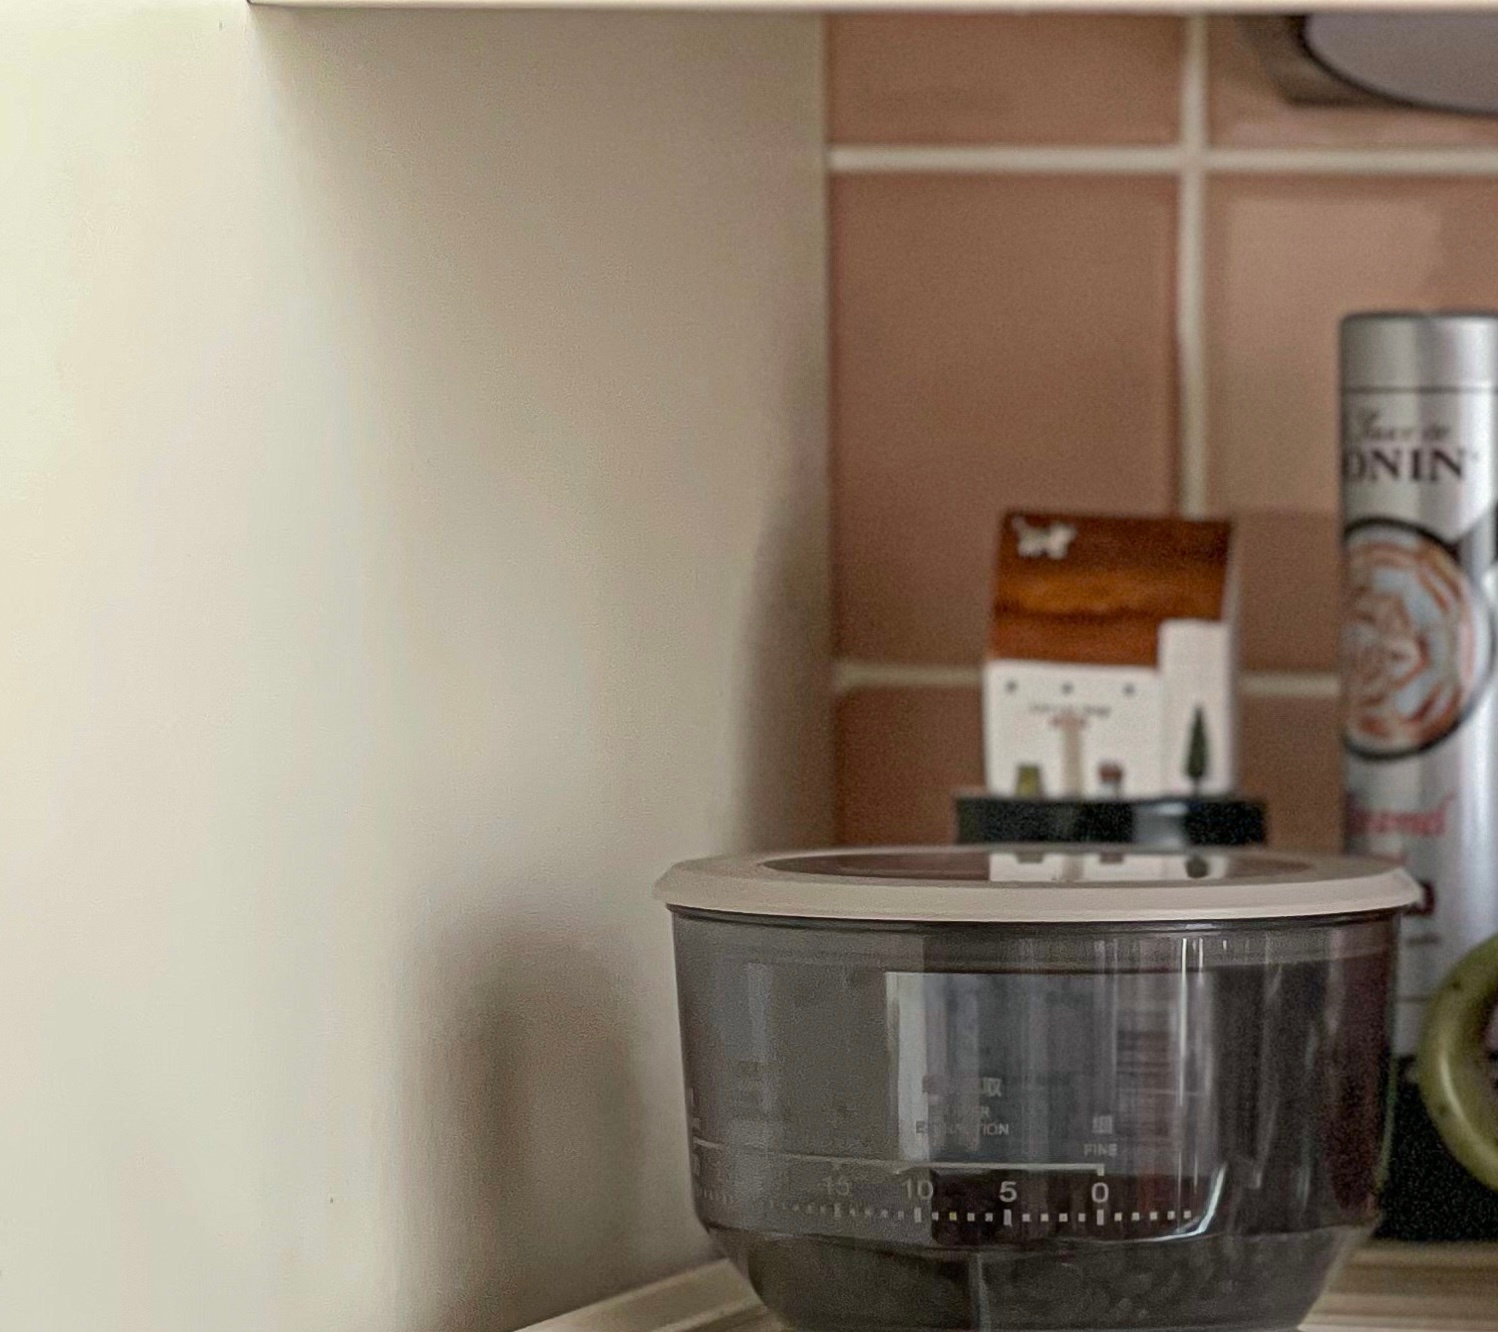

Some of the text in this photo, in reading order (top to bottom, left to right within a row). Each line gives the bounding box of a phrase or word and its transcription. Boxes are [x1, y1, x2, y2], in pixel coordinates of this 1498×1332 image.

[904, 1179, 934, 1201] 10
[1000, 1181, 1018, 1203] 5
[1091, 1182, 1110, 1203] 0
